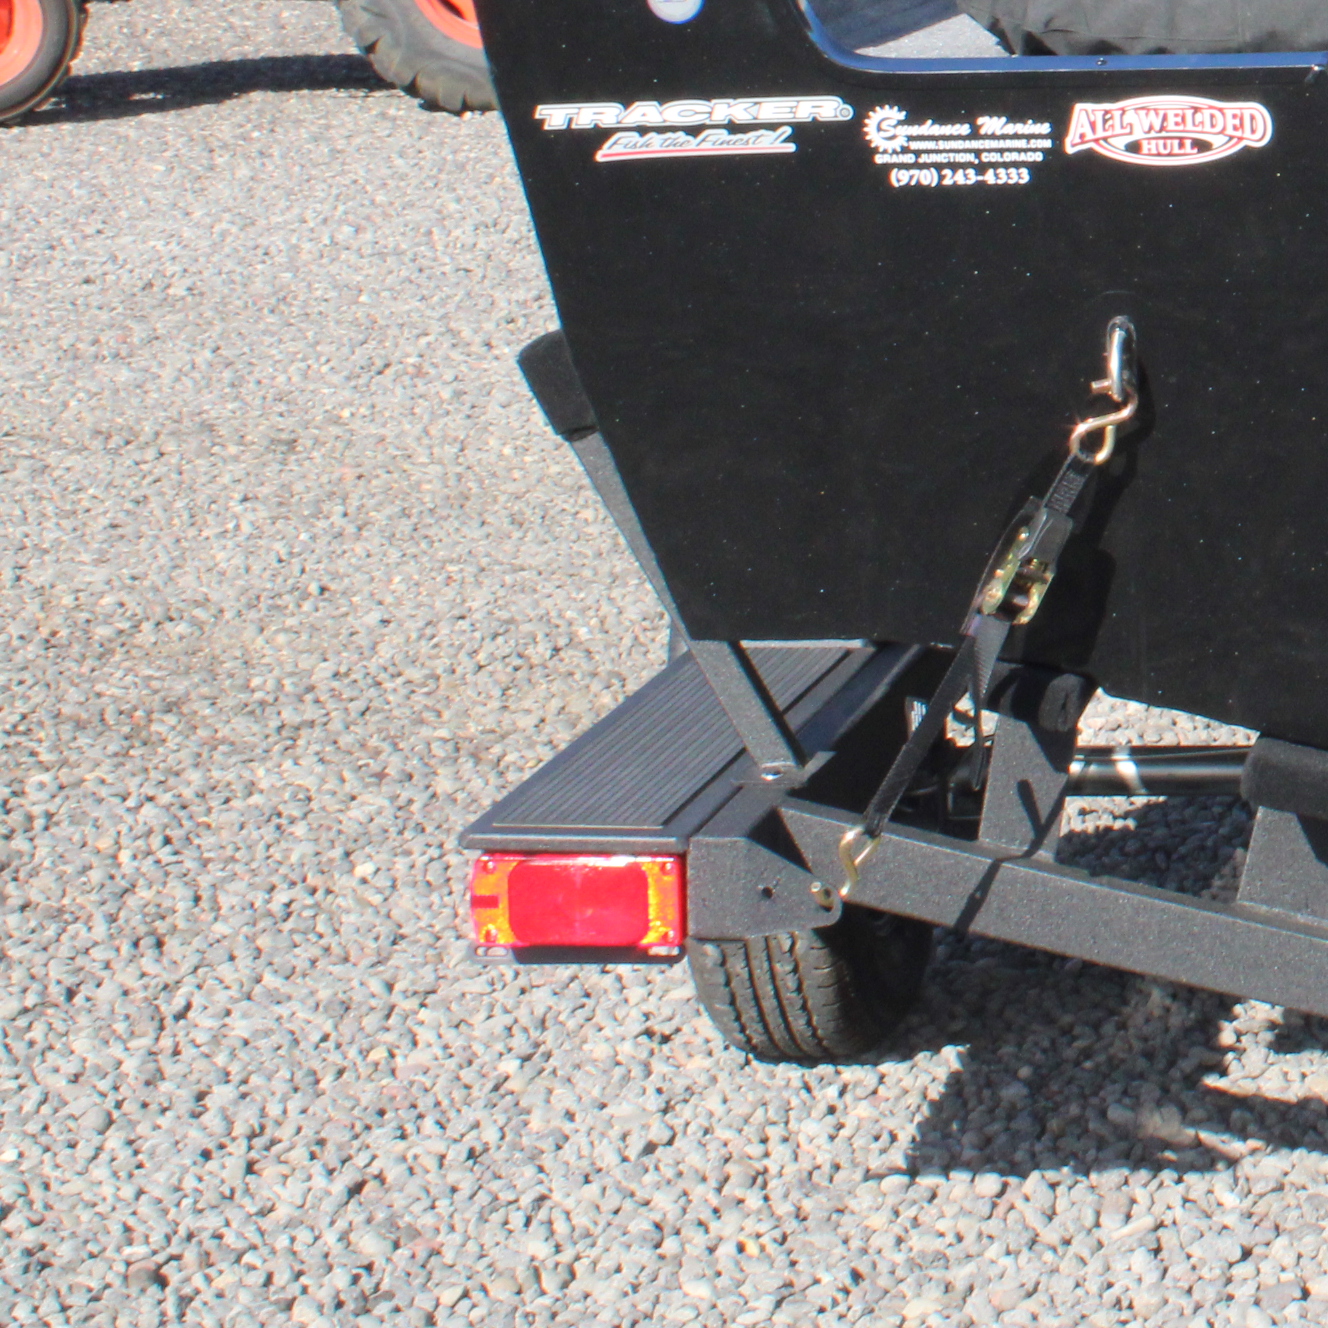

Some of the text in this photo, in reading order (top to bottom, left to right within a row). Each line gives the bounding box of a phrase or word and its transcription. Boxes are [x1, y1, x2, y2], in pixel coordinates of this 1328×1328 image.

[536, 96, 846, 129] TRACKER
[878, 116, 1052, 137] Sundance Marine
[1071, 107, 1267, 146] ALL WELDED
[606, 131, 656, 150] Fish
[659, 130, 692, 148] the
[909, 139, 1052, 150] WWW.SUNDANCEMARINE.COM
[1139, 139, 1199, 154] HULL
[874, 151, 1043, 165] GRAND JUNCTION, COLORADO
[889, 167, 1031, 188] (970) 243-4333
